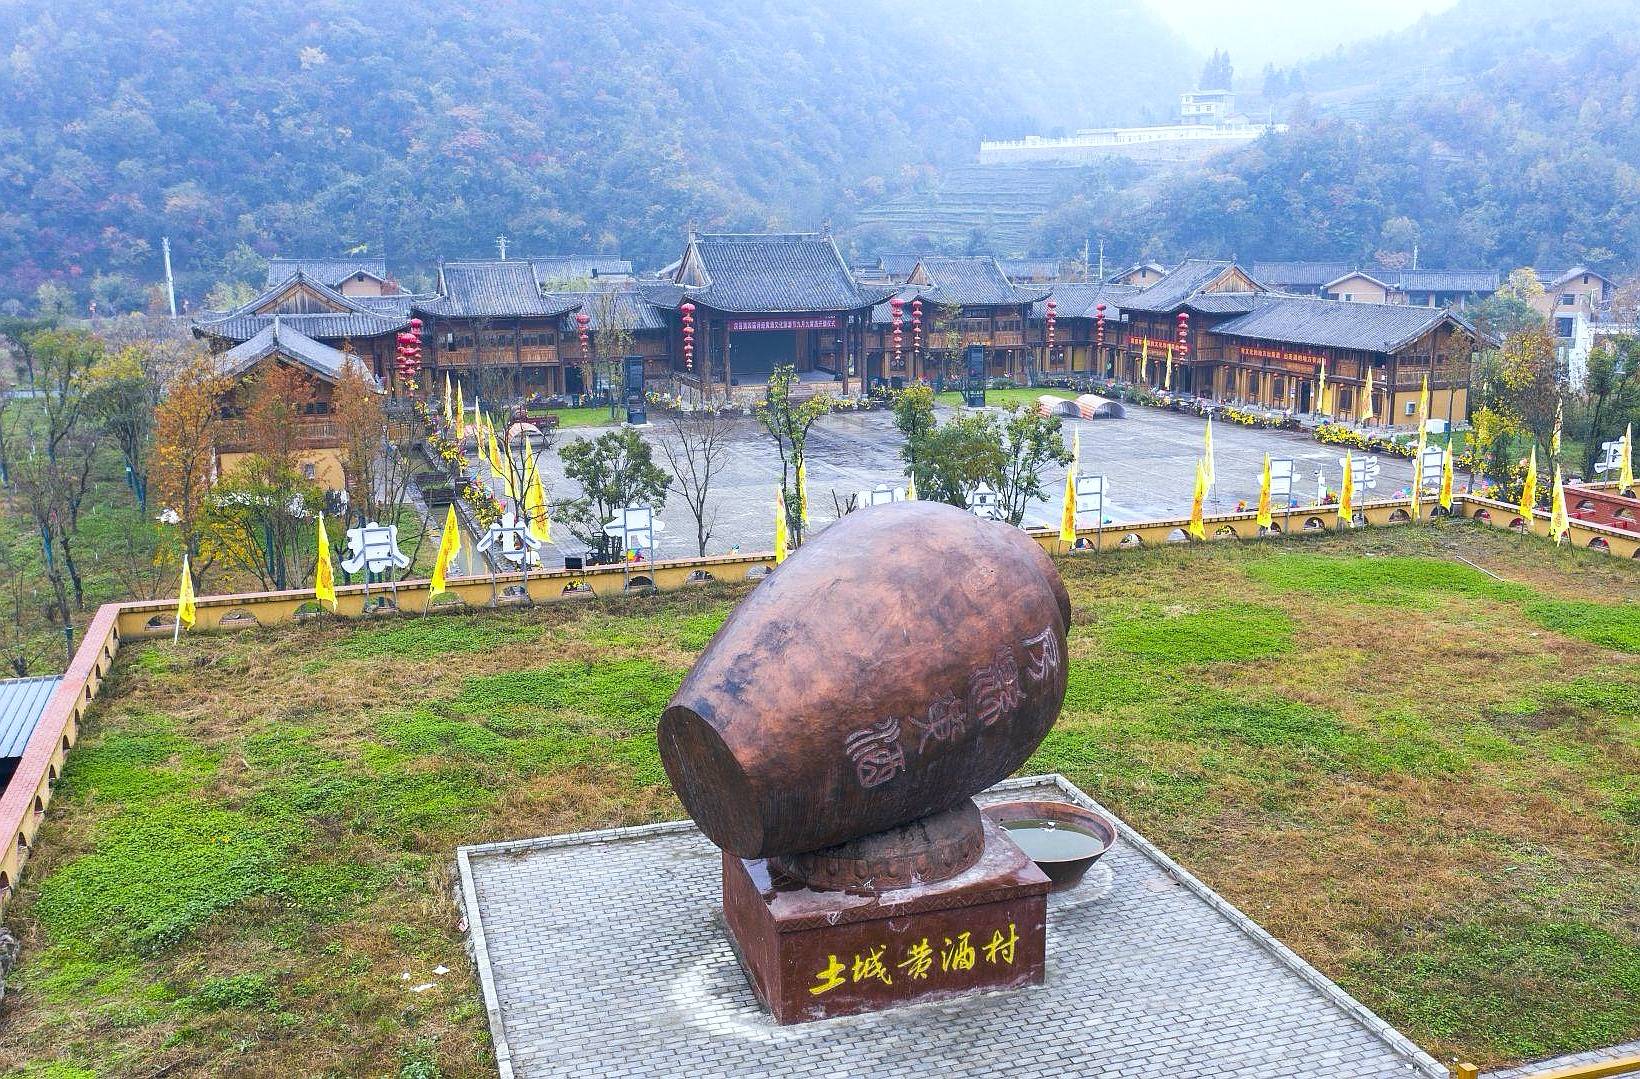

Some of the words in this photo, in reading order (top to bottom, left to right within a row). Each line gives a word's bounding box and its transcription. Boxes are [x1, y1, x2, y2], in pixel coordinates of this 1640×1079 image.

[808, 923, 1020, 995] 土城黄酒村
